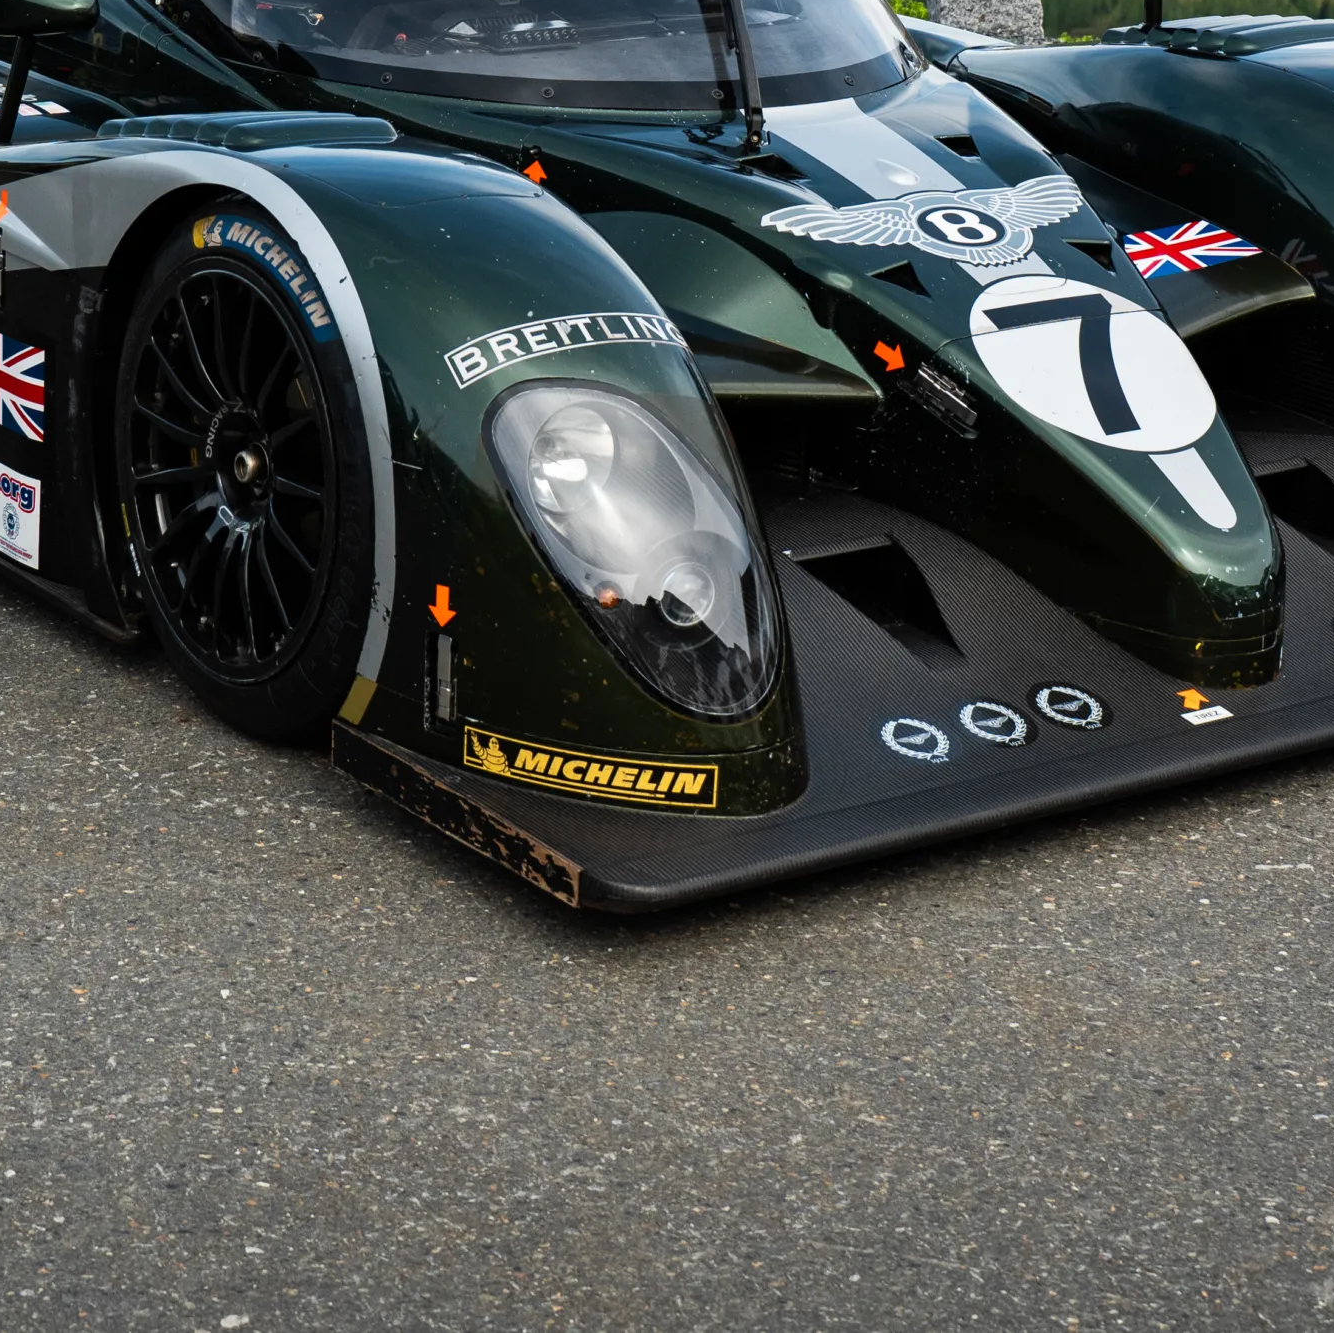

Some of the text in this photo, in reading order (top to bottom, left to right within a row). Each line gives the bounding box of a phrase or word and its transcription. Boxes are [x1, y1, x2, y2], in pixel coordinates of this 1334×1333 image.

[225, 221, 332, 329] MICHELIN
[451, 315, 687, 383] BREITLING
[982, 292, 1142, 437] 7
[205, 403, 230, 459] RACING
[513, 748, 707, 795] MICHELIN
